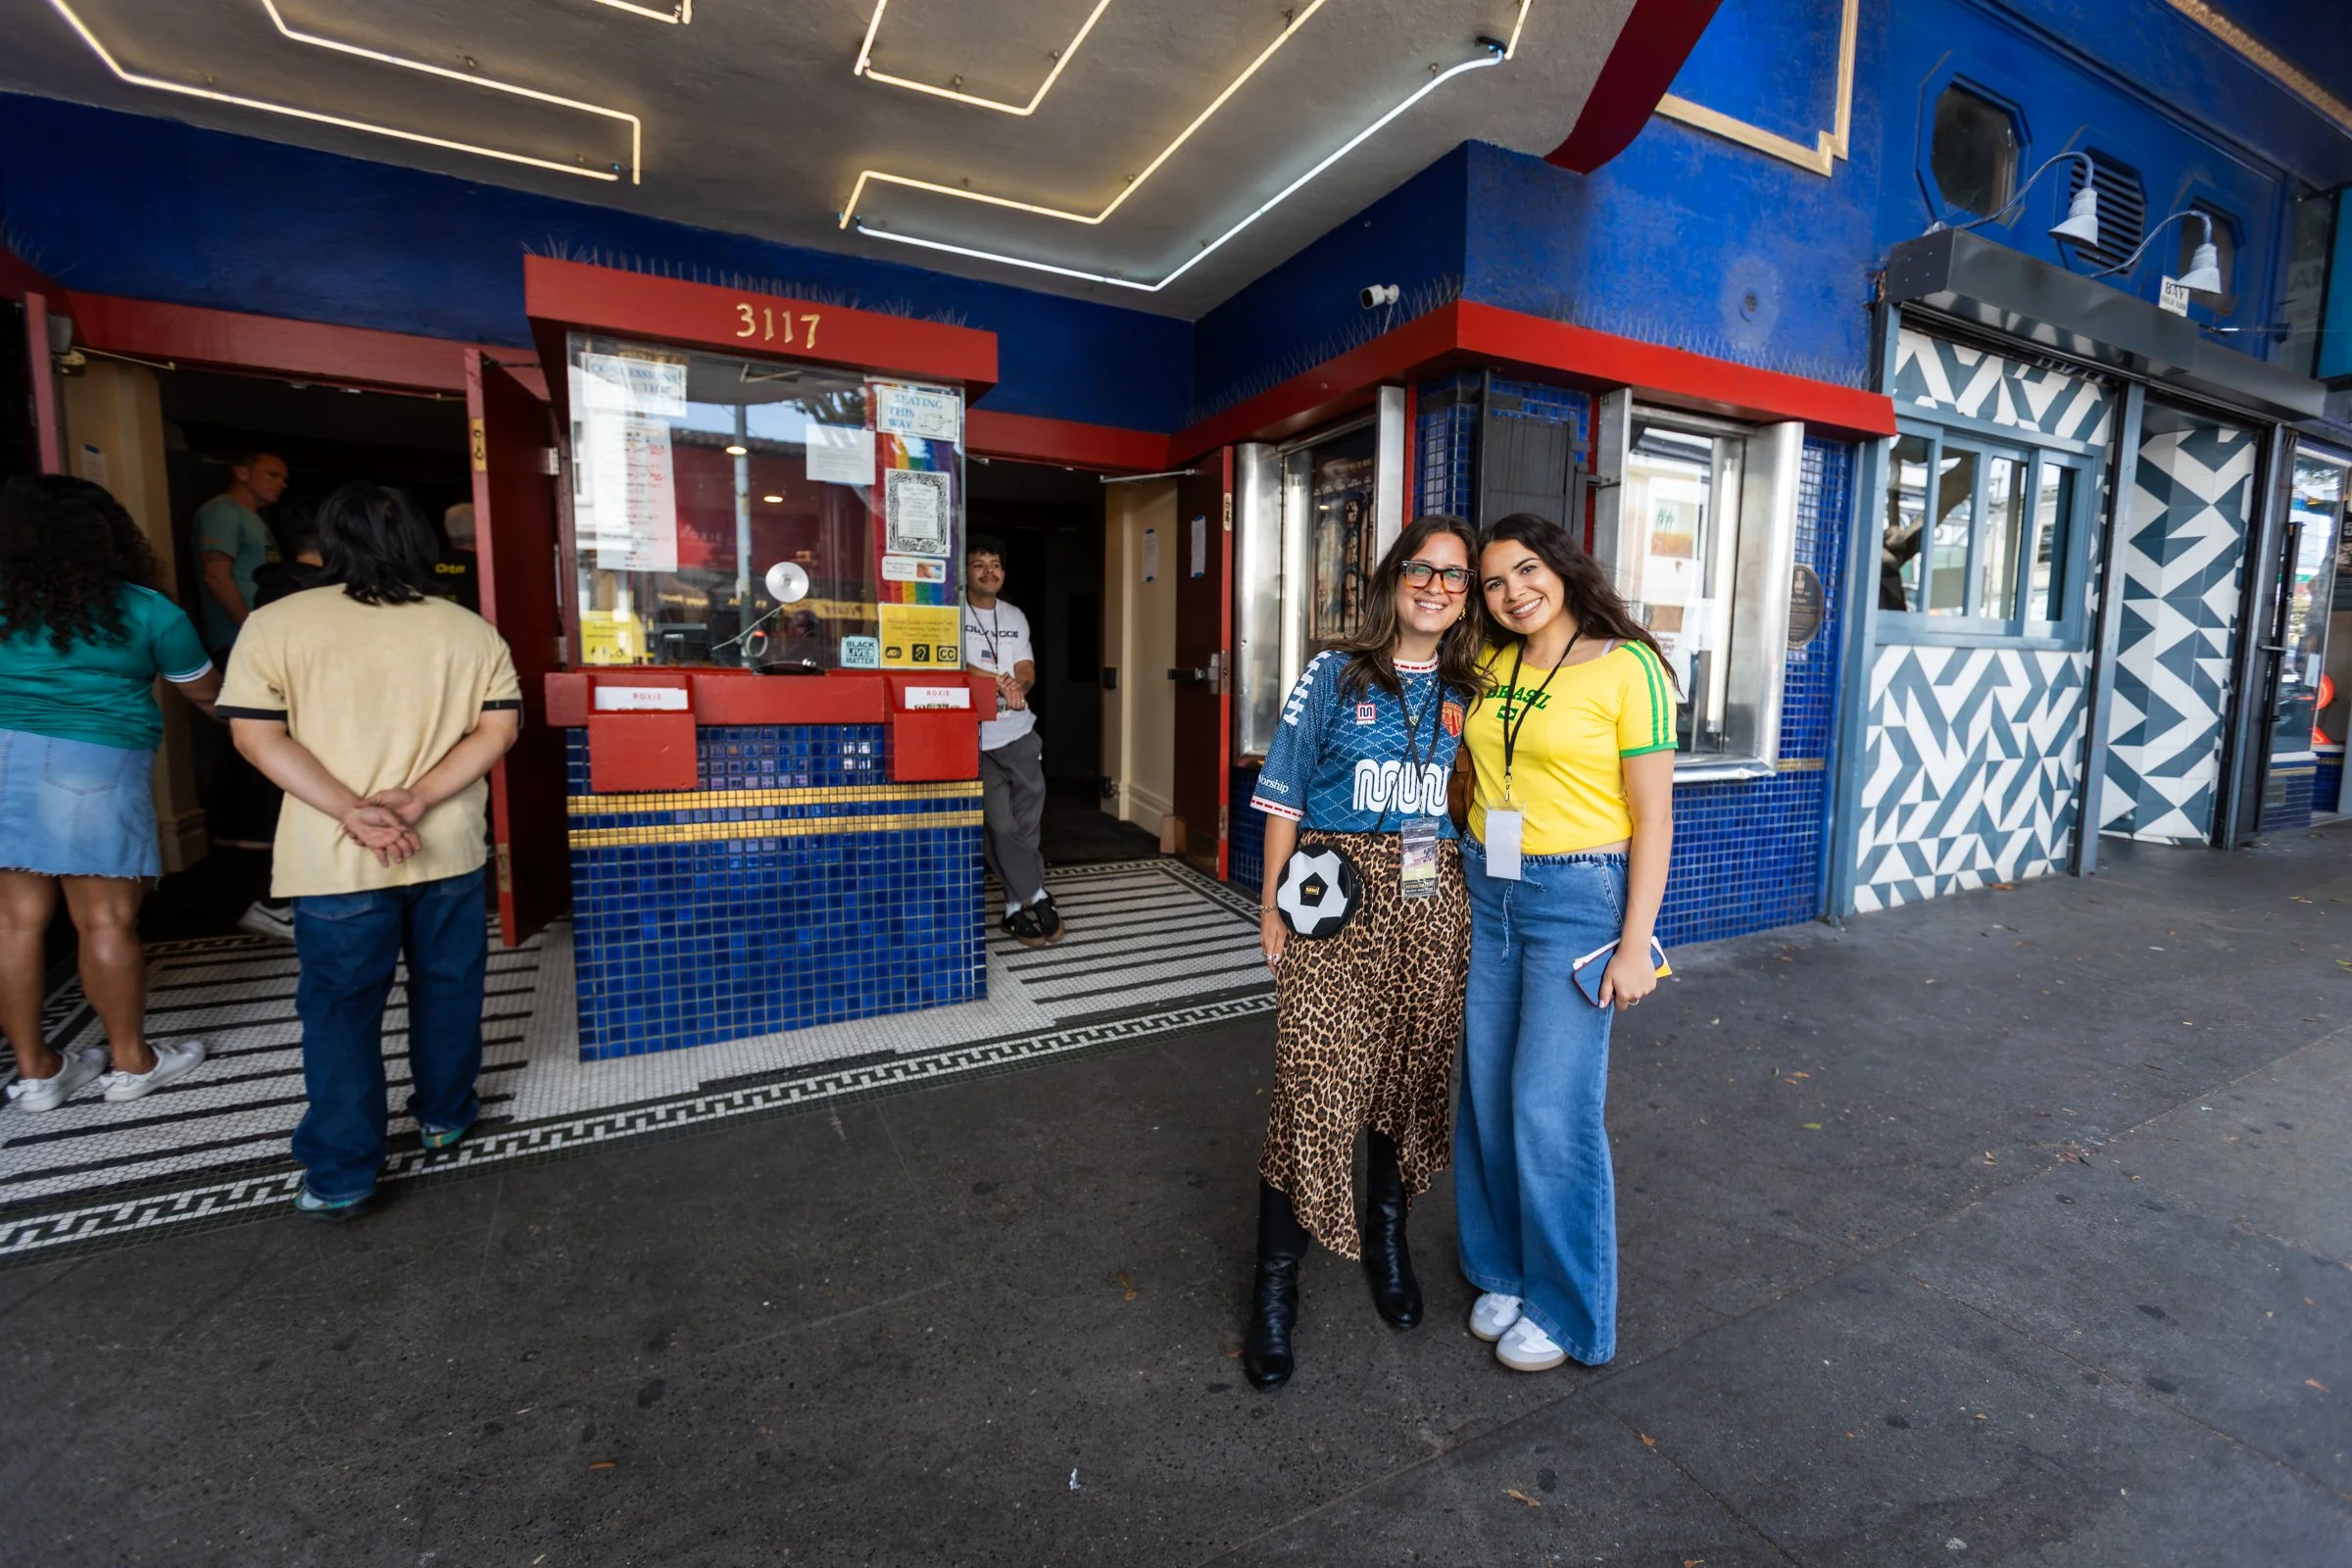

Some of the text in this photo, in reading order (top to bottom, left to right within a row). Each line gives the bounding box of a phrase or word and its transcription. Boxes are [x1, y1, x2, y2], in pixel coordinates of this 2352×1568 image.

[737, 303, 820, 349] 3117
[894, 393, 943, 410] SEATING
[889, 406, 914, 417] THIS
[888, 417, 911, 429] WAY
[847, 648, 874, 658] LIVES
[846, 657, 874, 665] MATTER
